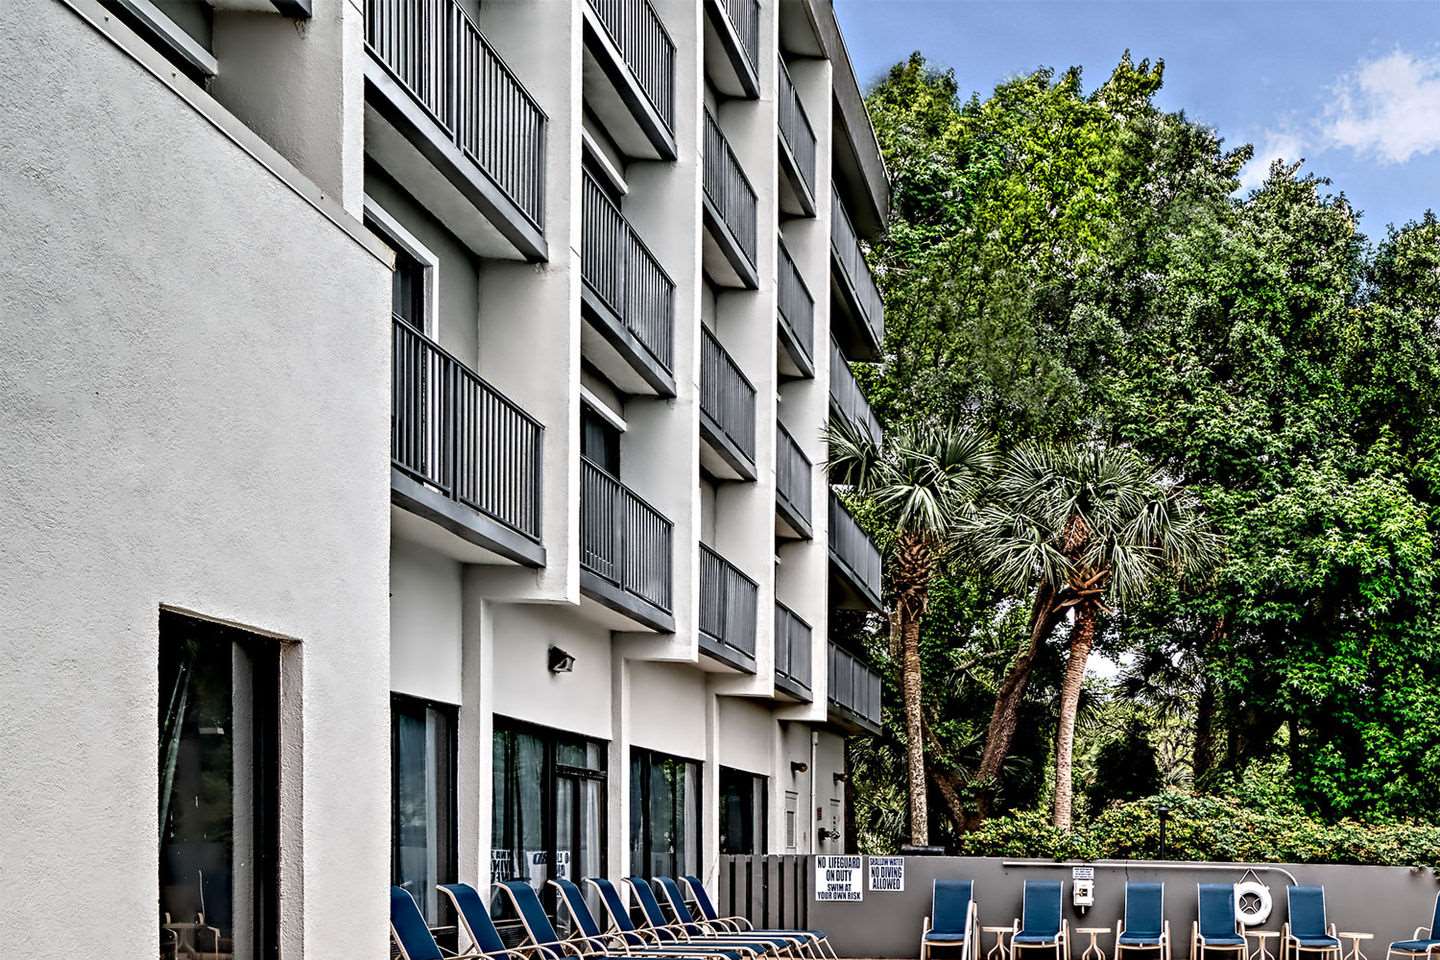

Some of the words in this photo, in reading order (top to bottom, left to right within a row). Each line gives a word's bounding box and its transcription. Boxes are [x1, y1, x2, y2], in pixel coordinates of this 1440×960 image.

[818, 857, 826, 868] NO
[829, 857, 860, 868] LIFEGUARD
[826, 869, 835, 881] ON
[835, 869, 853, 881] DUTY
[871, 866, 879, 878] NO
[880, 866, 902, 878] DIVING
[827, 883, 844, 892] SWIM
[873, 878, 900, 889] ALLOWED
